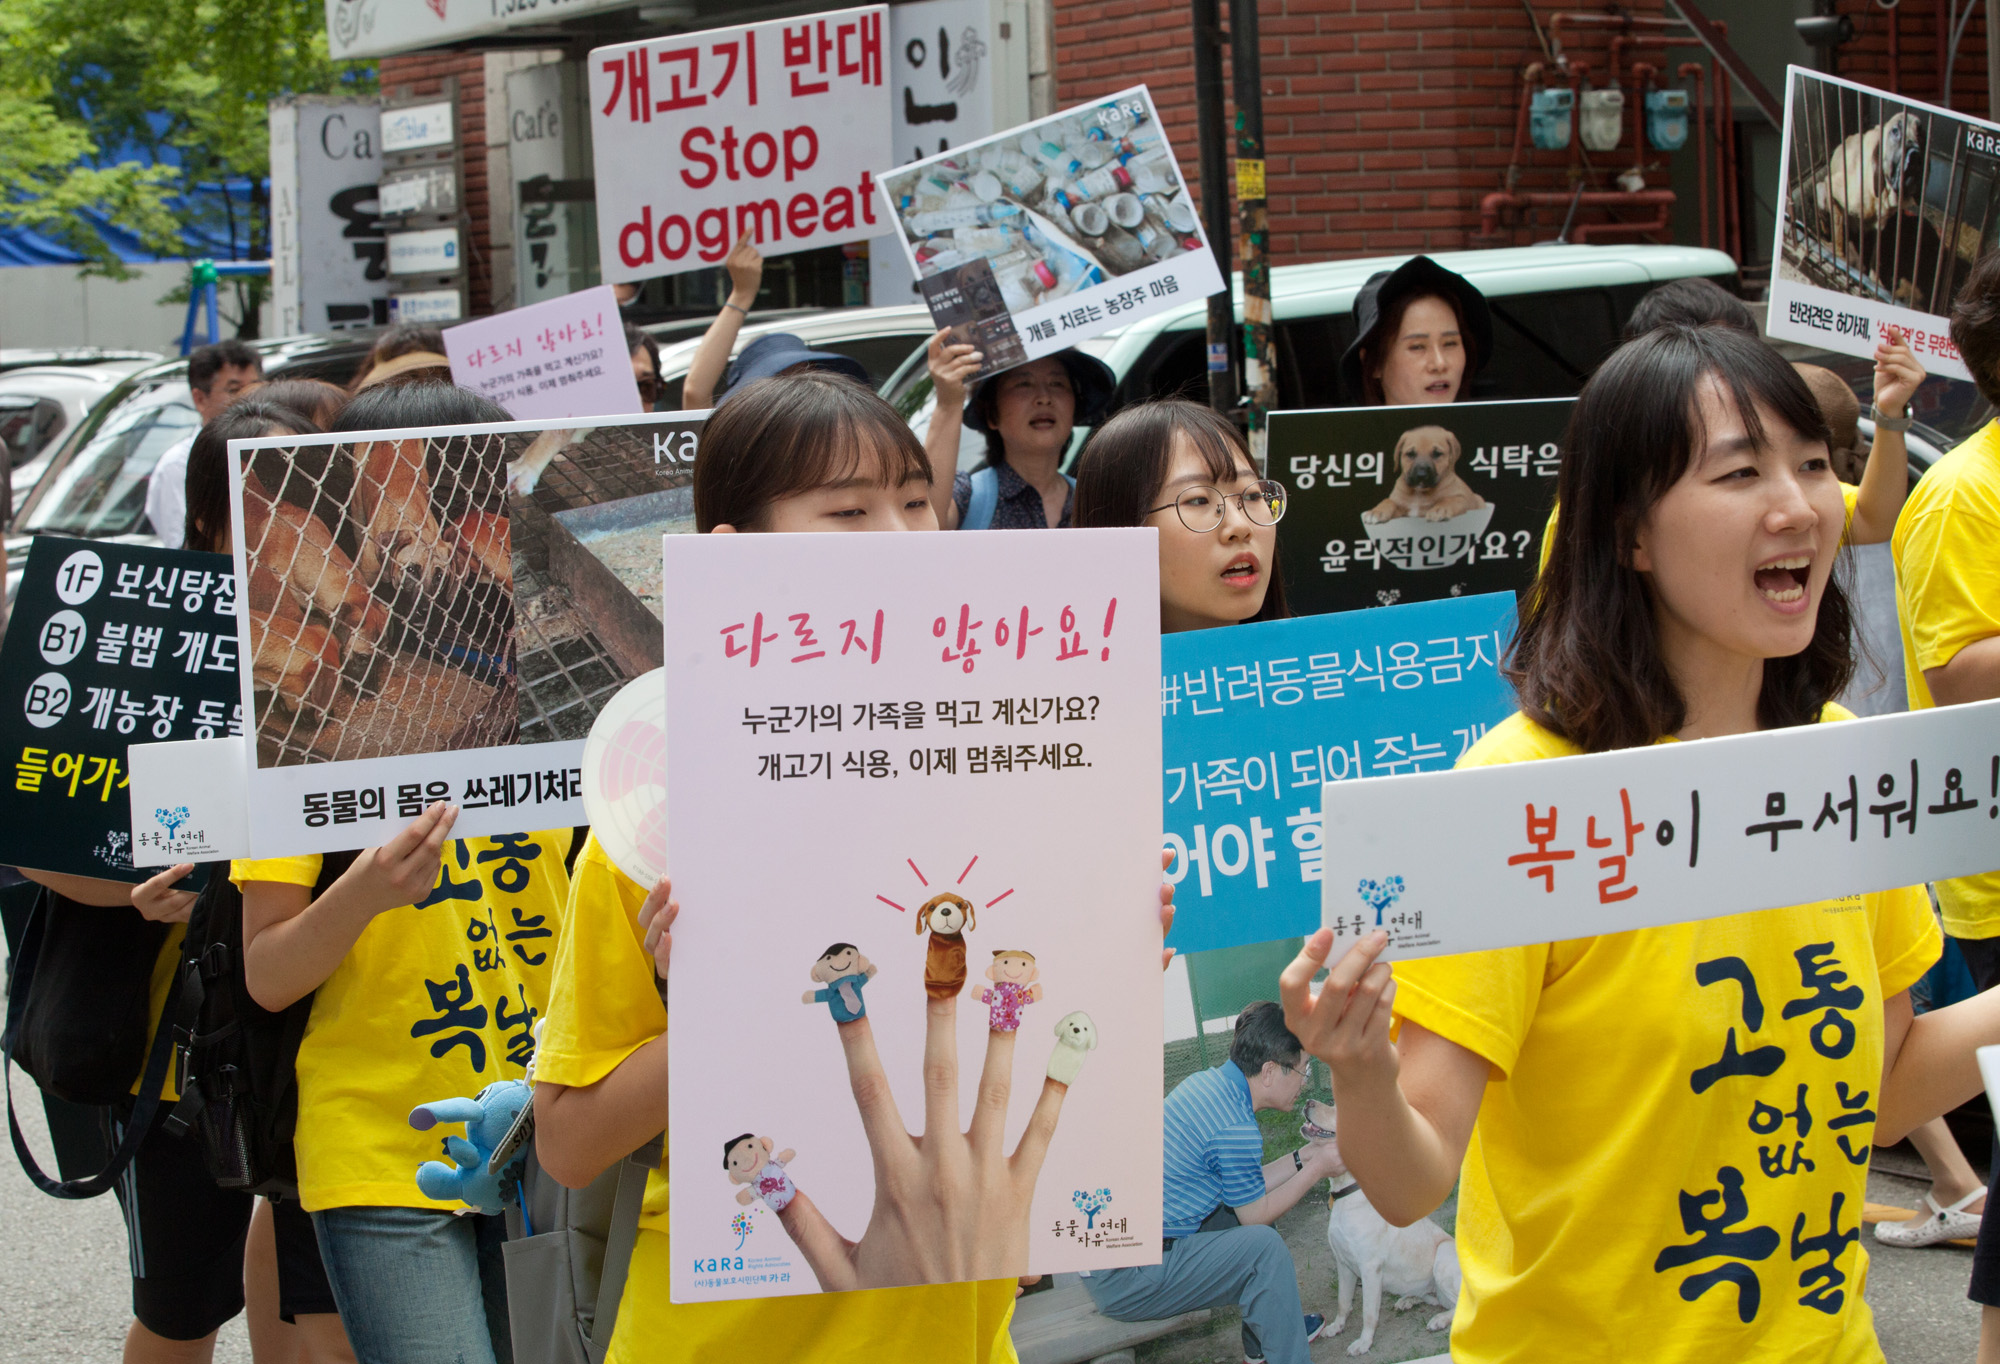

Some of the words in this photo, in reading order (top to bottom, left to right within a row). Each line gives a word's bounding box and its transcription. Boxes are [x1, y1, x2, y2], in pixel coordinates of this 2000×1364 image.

[602, 31, 757, 123] 개고기
[783, 12, 882, 97] 반대
[680, 125, 819, 189] Stop
[619, 170, 876, 268] dogmeat
[467, 338, 523, 368] 다르지
[536, 312, 604, 353] 않아요!
[1026, 318, 1056, 343] 개들
[1059, 304, 1103, 332] 치료는
[1104, 287, 1147, 316] 농장주
[1149, 275, 1180, 299] 마음
[1789, 301, 1834, 331] 반려견은
[1836, 312, 1871, 343] 허가제,
[1289, 452, 1384, 489] 당신의
[1470, 443, 1562, 479] 식탁은
[64, 563, 99, 593] 1F
[1320, 530, 1531, 573] 윤리적인가요?
[43, 622, 81, 654] B1
[96, 622, 163, 668] 불법
[720, 608, 885, 668] 다르지
[932, 597, 1118, 674] 않아요!
[1161, 630, 1504, 716] #반려동물식용금지
[26, 685, 69, 717] B2
[80, 687, 183, 738] 개농장
[741, 704, 842, 734] 누군가의
[853, 701, 926, 730] 가족을
[935, 698, 983, 727] 먹고
[992, 695, 1100, 726] 계신가요?
[16, 746, 130, 802] 들어가
[757, 752, 832, 782] 개고기
[841, 748, 900, 779] 식용,
[908, 745, 957, 776] 이제
[966, 742, 1093, 774] 멈춰주세요.
[1165, 752, 1281, 810] 가족이
[1291, 740, 1364, 789] 되어
[302, 786, 386, 828] 동물의
[1508, 788, 1699, 905] 복날이
[1745, 754, 2000, 852] 무서워요!
[466, 907, 552, 972] 없는
[411, 963, 538, 1074] 복날
[1690, 940, 1864, 1094] 고통
[1747, 1081, 1877, 1178] 없는
[1654, 1166, 1860, 1324] 복날
